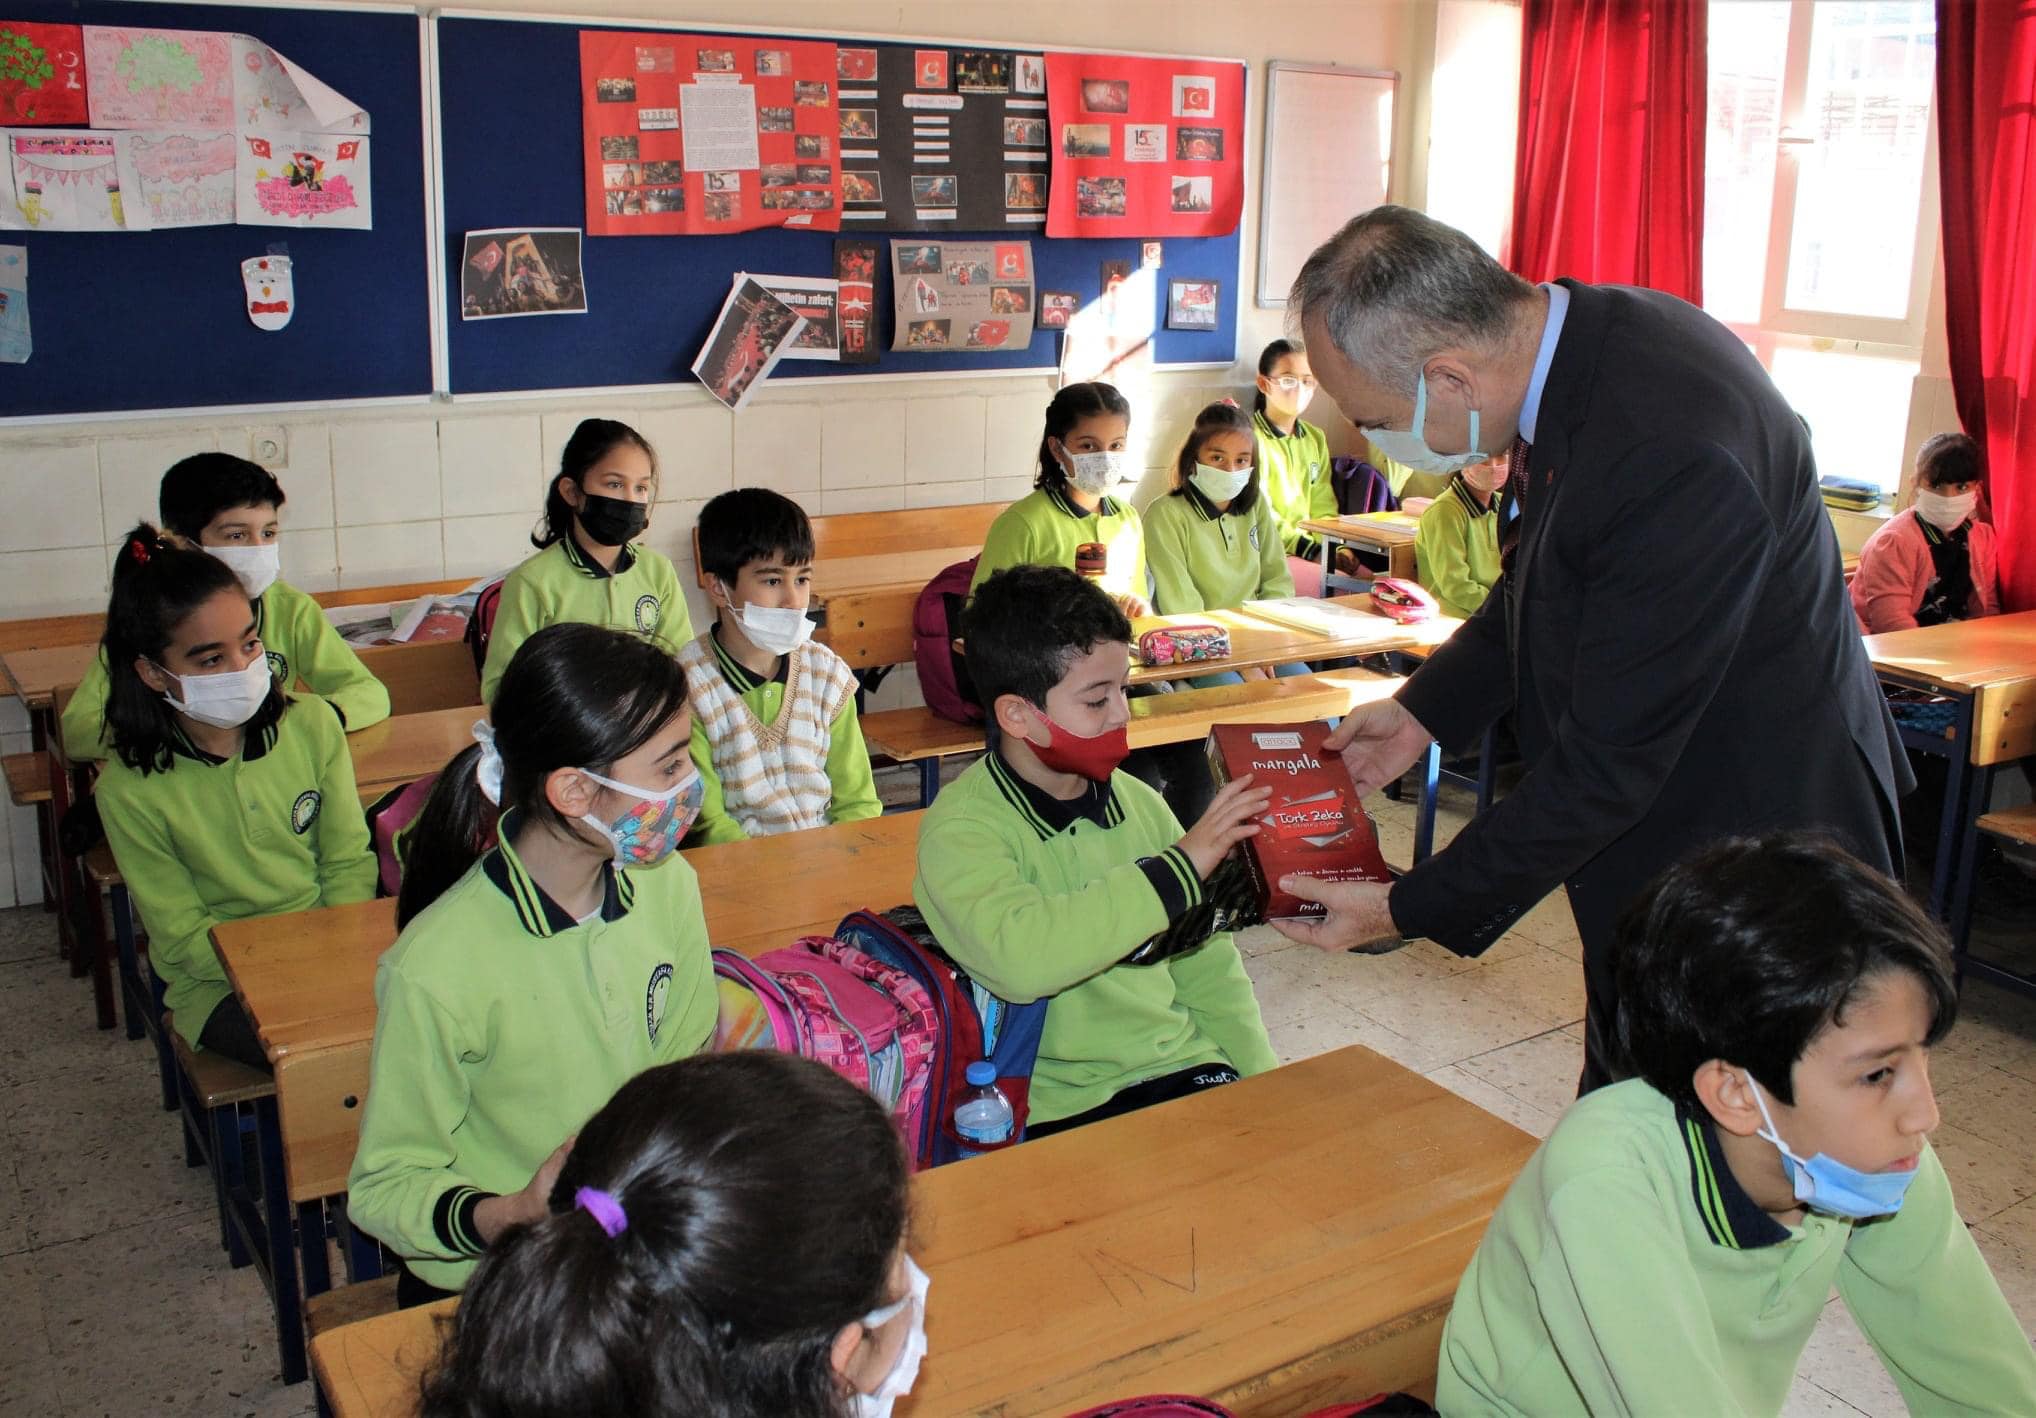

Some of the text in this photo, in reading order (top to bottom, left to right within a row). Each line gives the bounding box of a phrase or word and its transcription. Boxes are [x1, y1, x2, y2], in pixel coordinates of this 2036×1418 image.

[1135, 129, 1152, 146] 15
[1252, 753, 1321, 775] mangala
[1310, 809, 1344, 821] Zeka
[1193, 1071, 1231, 1085] Just
